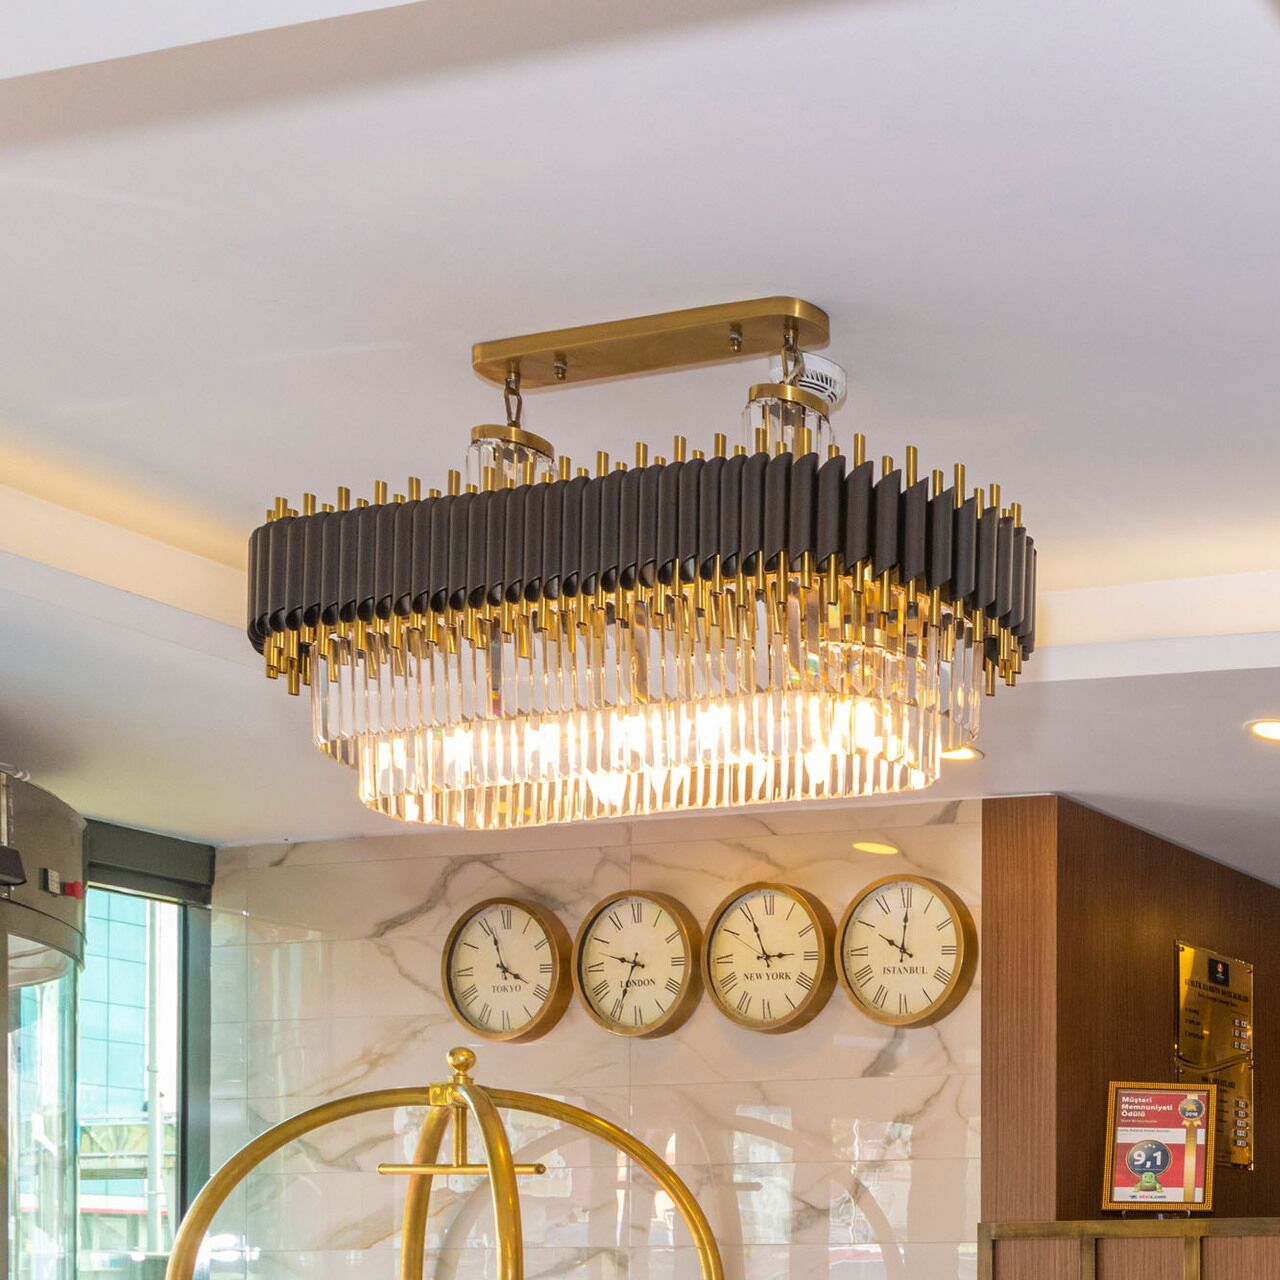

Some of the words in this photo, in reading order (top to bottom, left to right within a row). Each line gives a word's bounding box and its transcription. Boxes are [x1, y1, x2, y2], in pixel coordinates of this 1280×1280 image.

[744, 973, 762, 981] NEW
[765, 972, 791, 980] YORK
[620, 978, 656, 988] LONDON
[492, 985, 521, 993] TOKYO
[1122, 1096, 1152, 1104] Müşteri
[1121, 1104, 1173, 1112] Memnuniyeti
[1133, 1150, 1162, 1168] 9,1
